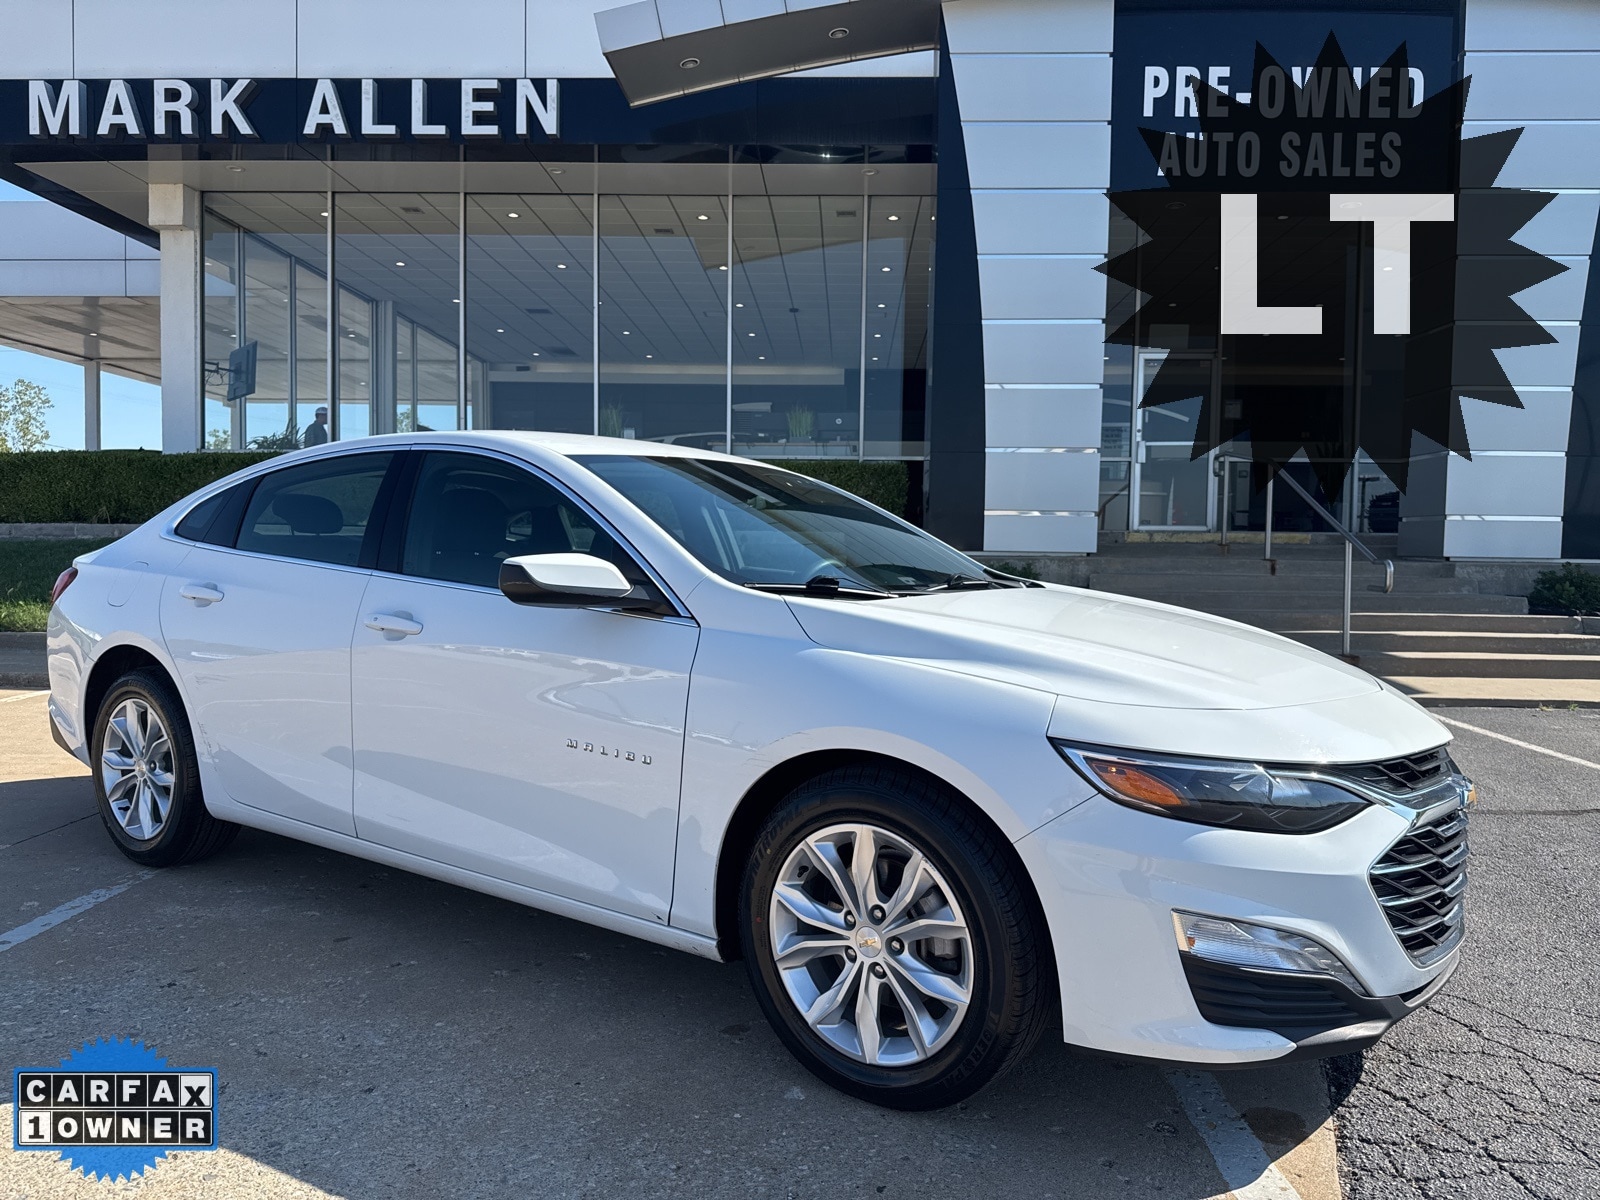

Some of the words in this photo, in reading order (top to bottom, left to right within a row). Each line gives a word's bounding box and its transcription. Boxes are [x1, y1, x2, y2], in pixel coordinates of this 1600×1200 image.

[28, 78, 255, 136] MARK
[302, 78, 559, 136] ALLEN
[1143, 66, 1425, 119] PRE-OWNED
[1157, 132, 1261, 177] AUTO
[1279, 132, 1402, 178] SALES
[566, 738, 652, 765] MALIBU
